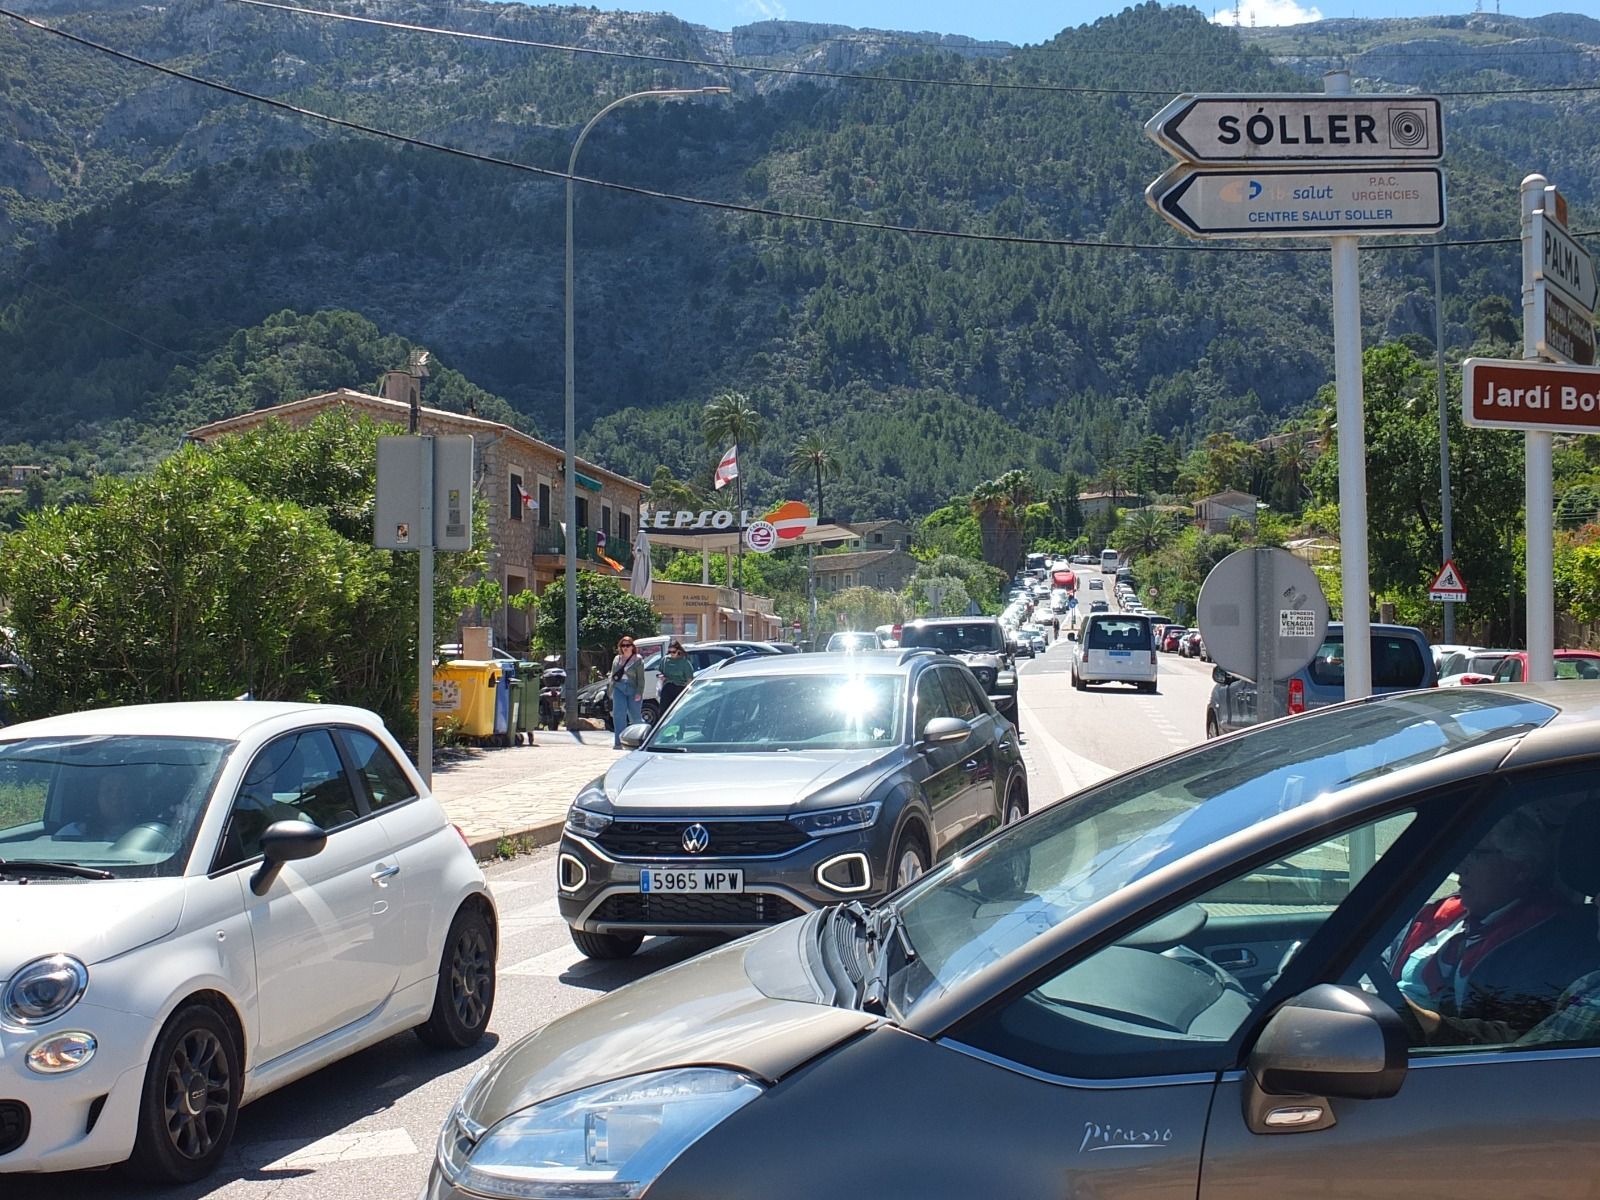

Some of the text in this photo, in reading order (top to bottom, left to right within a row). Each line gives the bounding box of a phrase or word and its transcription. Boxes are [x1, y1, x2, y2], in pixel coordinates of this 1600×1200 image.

[1217, 107, 1378, 145] SÓLLER
[1292, 185, 1334, 200] salut
[1369, 176, 1399, 187] P.A.C.
[1248, 209, 1393, 223] CENTRE SALUT SOLLER
[1544, 229, 1581, 291] PALMA
[1482, 381, 1552, 409] Jardí
[653, 872, 739, 890] 5965 MPW
[1079, 1121, 1173, 1154] Picasso
